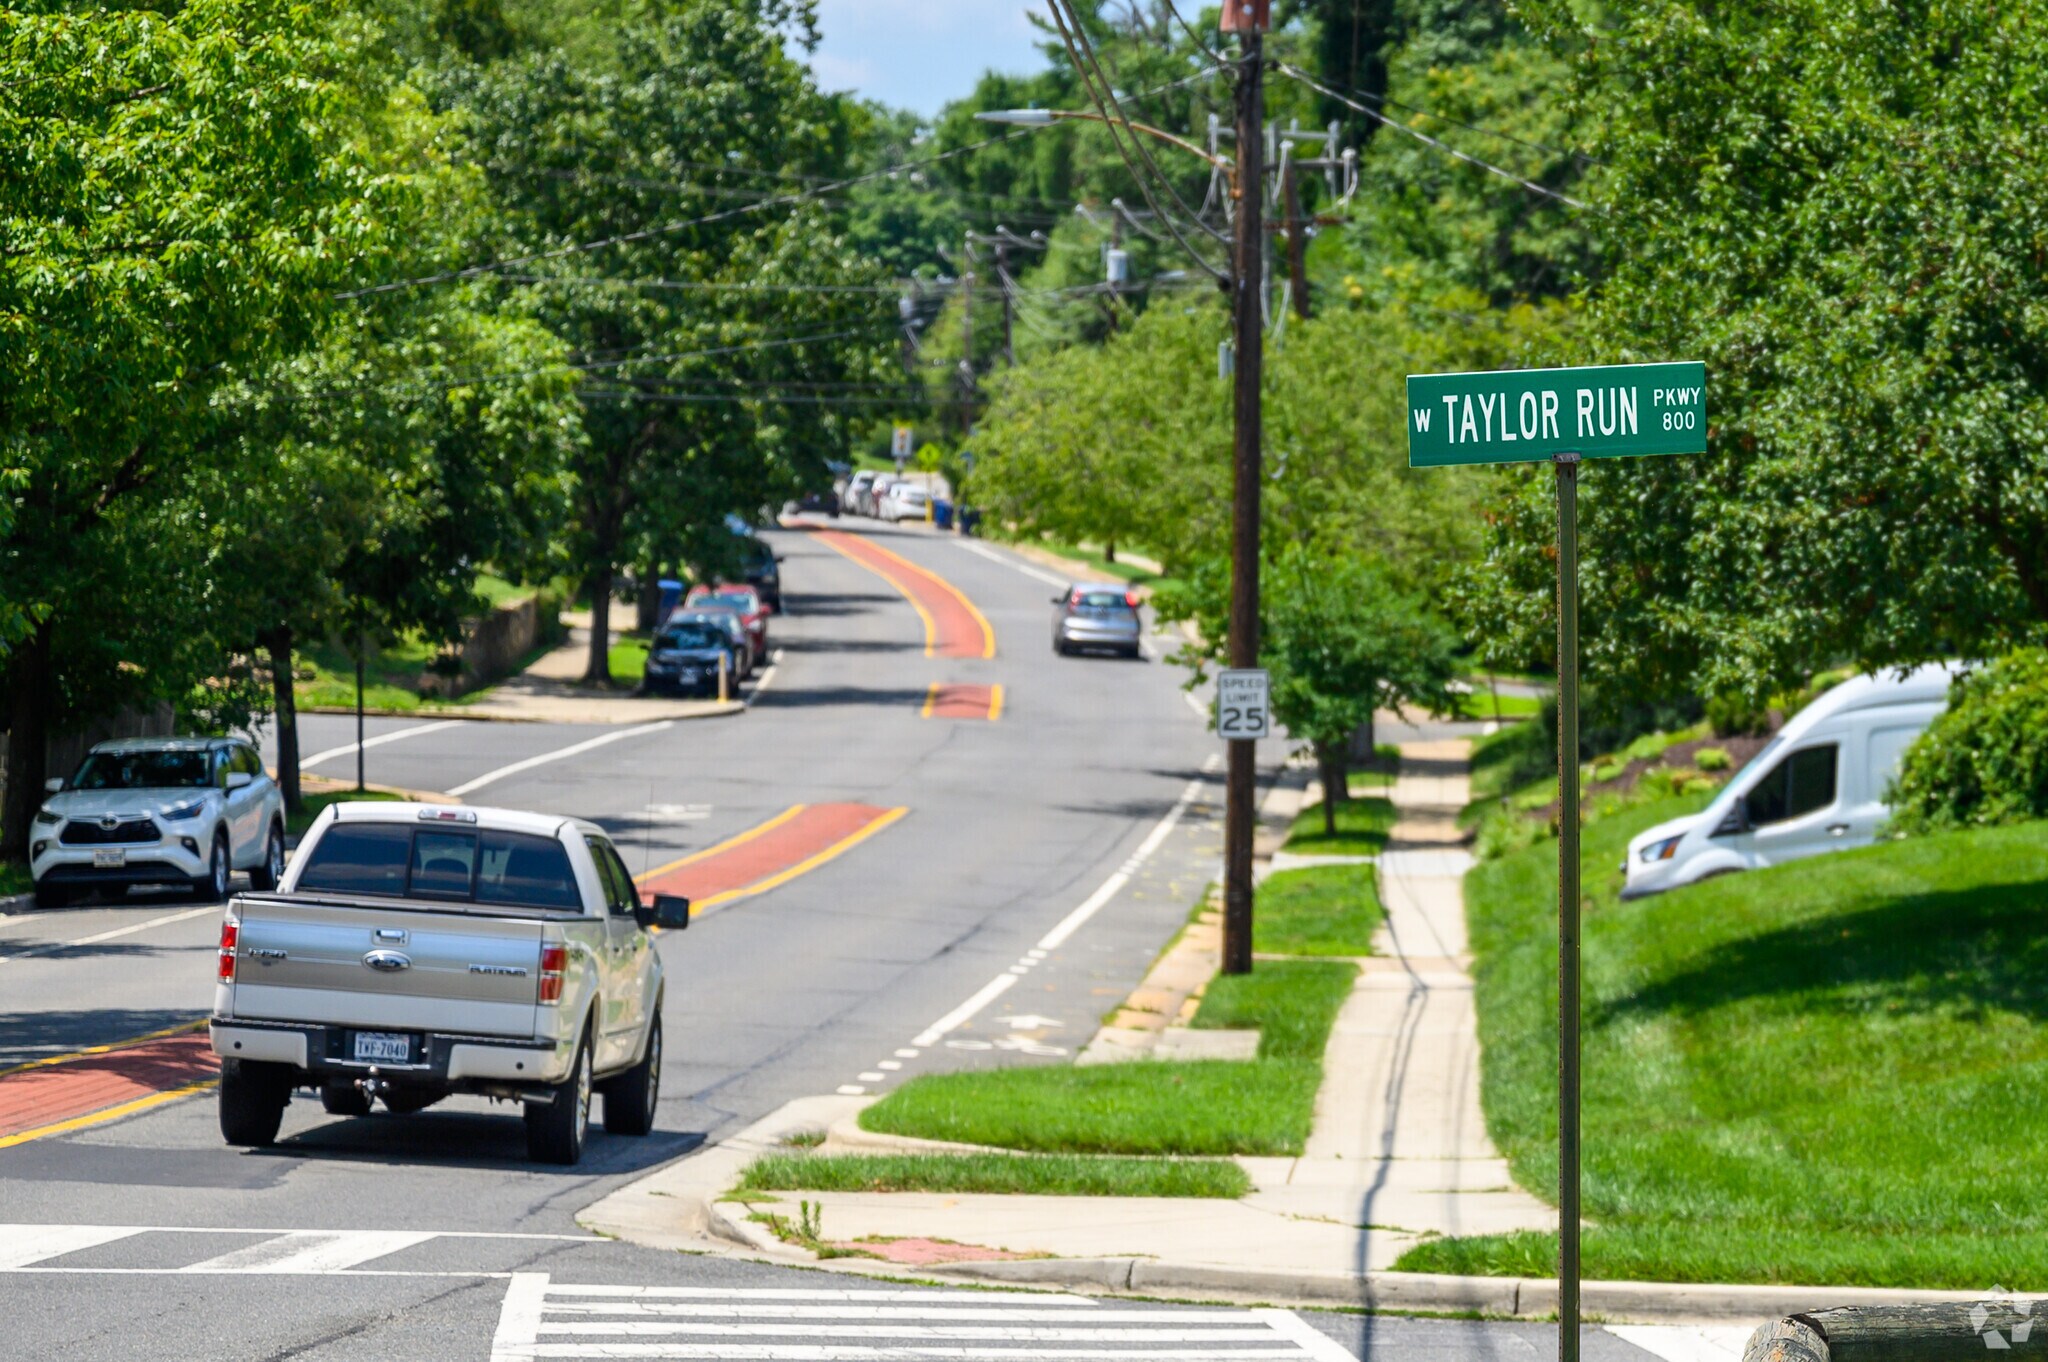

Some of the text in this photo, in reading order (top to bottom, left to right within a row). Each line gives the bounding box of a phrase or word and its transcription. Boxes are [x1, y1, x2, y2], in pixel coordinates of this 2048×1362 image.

[1414, 386, 1701, 444] W TAYLOR RUN PKWY
[1662, 411, 1695, 431] 800
[1223, 678, 1264, 688] SPEED
[1226, 692, 1259, 702] LIMIT
[1223, 707, 1263, 731] 25
